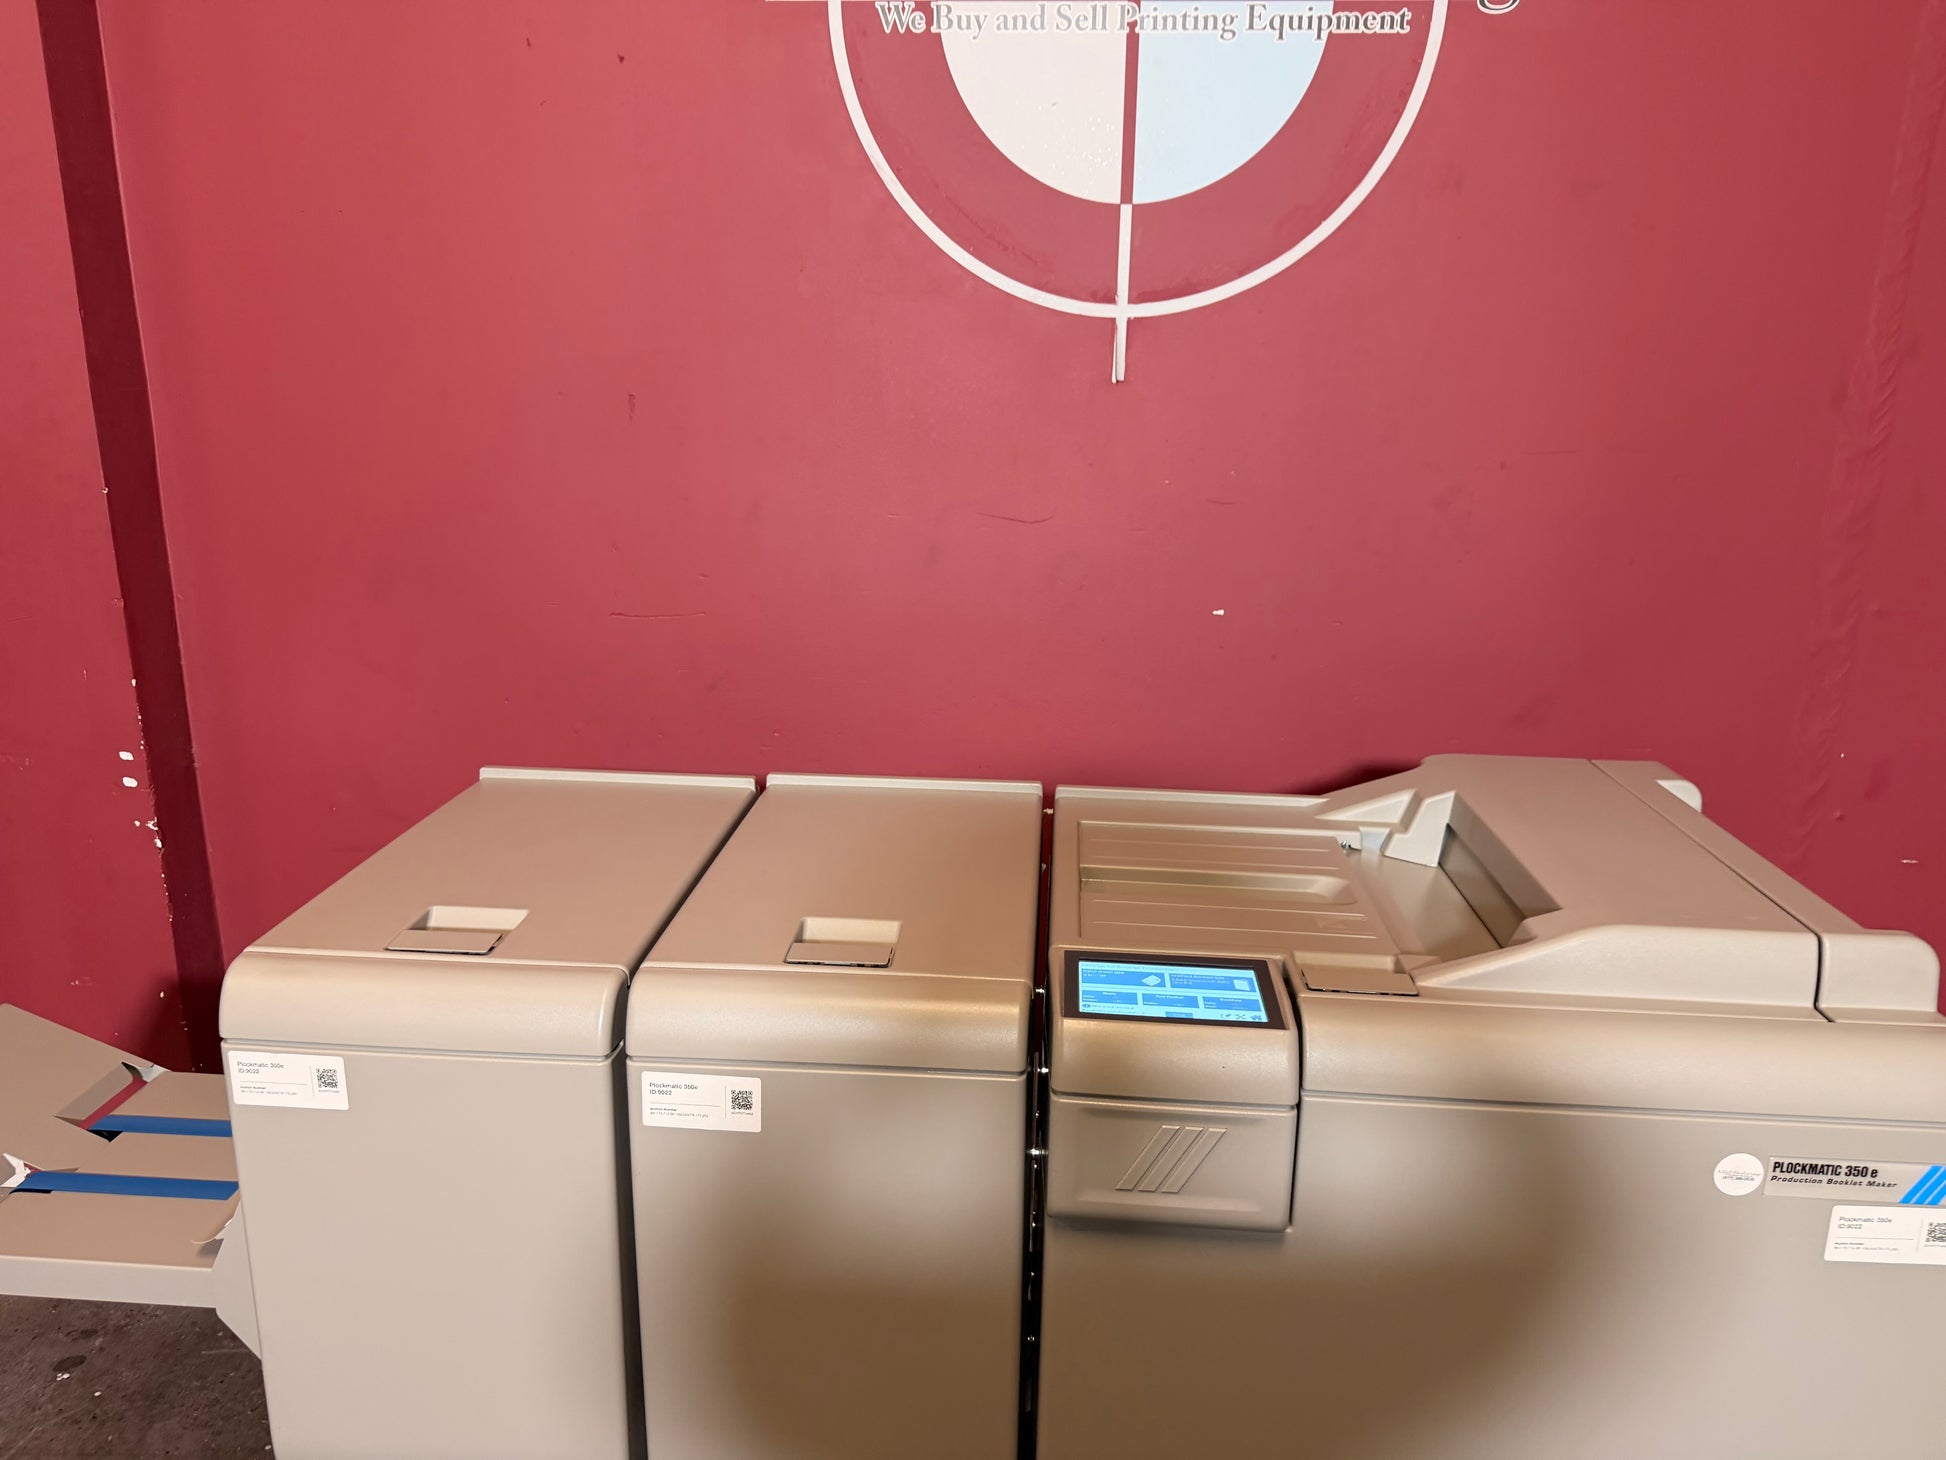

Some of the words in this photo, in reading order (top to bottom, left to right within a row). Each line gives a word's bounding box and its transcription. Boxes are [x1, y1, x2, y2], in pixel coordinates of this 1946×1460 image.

[877, 2, 926, 32] We
[932, 2, 988, 39] Buy
[996, 3, 1047, 32] and
[1055, 3, 1108, 32] Sell
[1117, 3, 1239, 40] Printing
[1245, 4, 1410, 41] Equipment
[1772, 1161, 1843, 1177] PLOCKMATIC
[1844, 1165, 1869, 1178] 350
[1870, 1168, 1879, 1178] e
[1770, 1175, 1823, 1185] Production
[1826, 1178, 1863, 1186] Booklet
[1866, 1180, 1898, 1188] Maker
